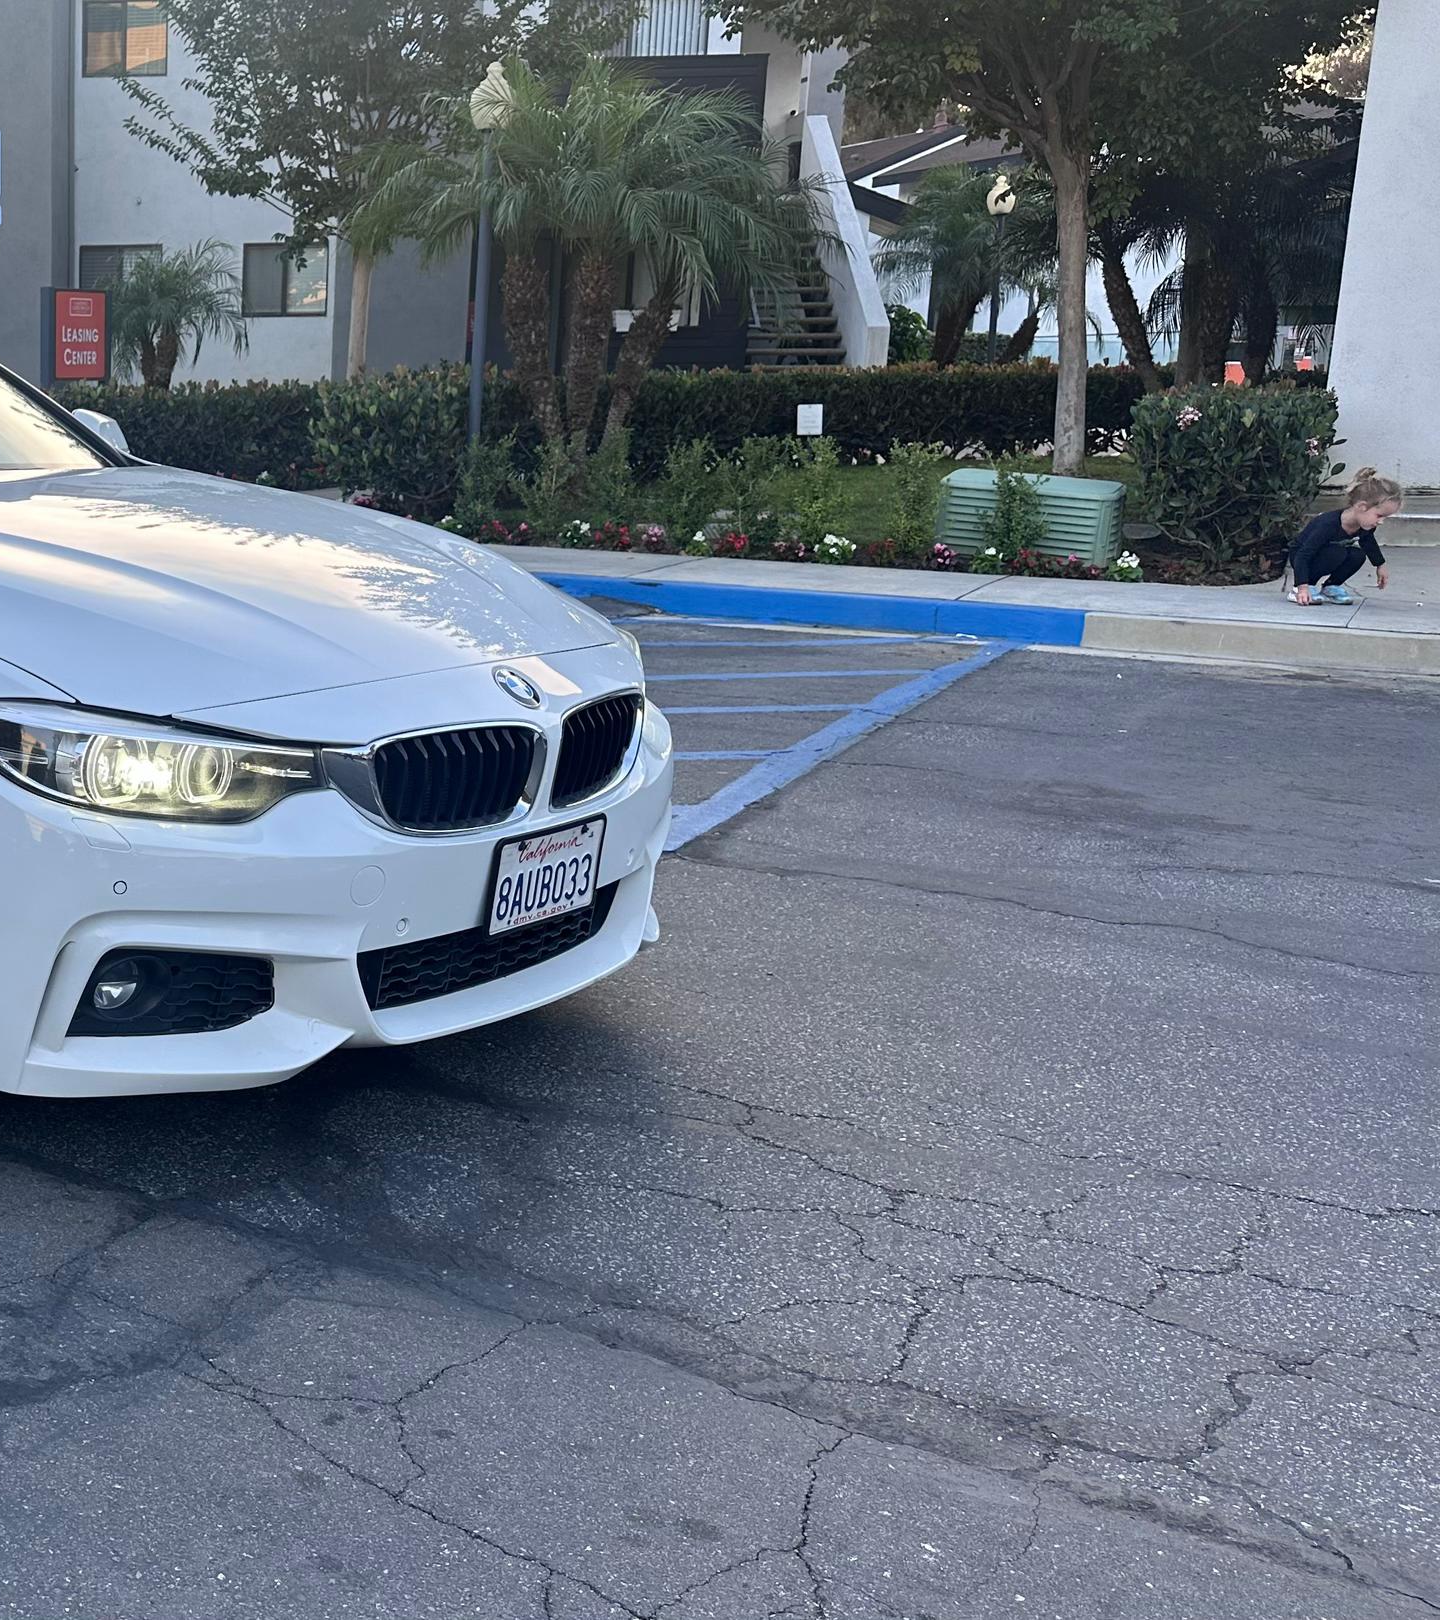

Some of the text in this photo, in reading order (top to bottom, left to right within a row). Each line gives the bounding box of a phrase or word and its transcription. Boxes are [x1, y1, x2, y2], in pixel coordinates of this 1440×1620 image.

[62, 325, 99, 343] LEASING
[63, 348, 97, 366] CENTER
[519, 835, 584, 864] California
[496, 853, 593, 921] 8AUB033
[513, 903, 569, 925] dmv.ca.gov
